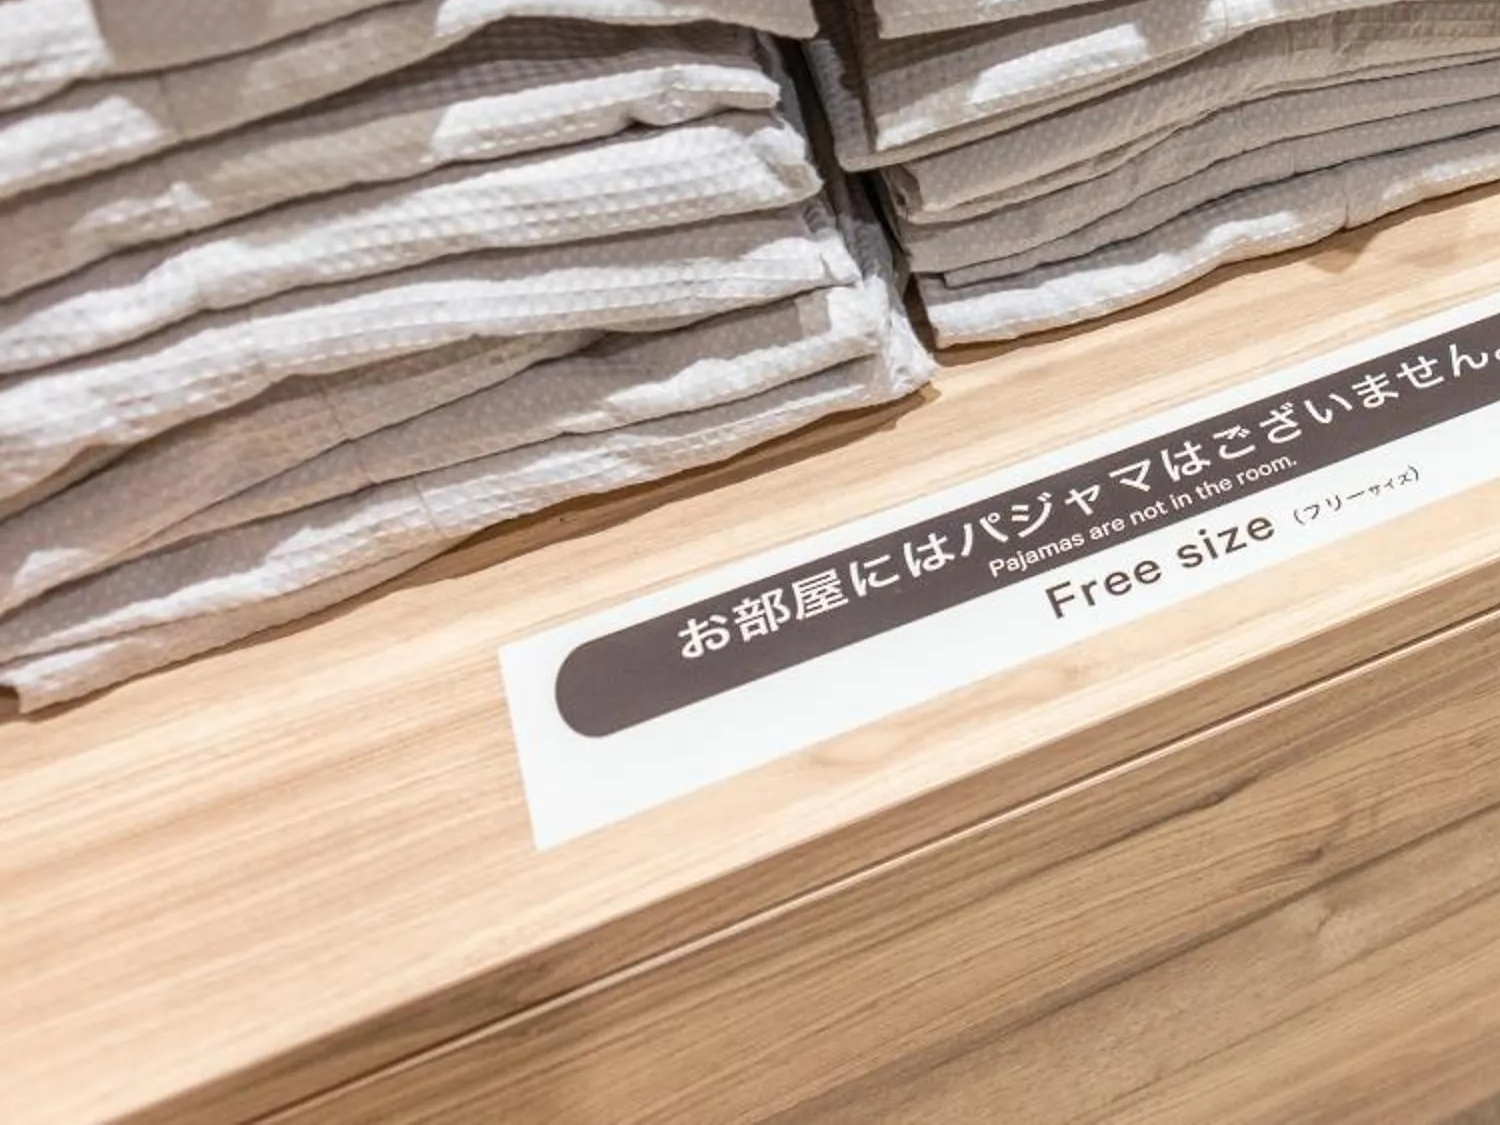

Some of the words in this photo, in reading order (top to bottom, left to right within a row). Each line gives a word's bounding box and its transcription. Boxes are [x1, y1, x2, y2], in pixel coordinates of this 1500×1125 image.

[988, 530, 1086, 579] Pajamas
[1089, 514, 1126, 541] are
[1129, 499, 1169, 527] not
[1169, 493, 1194, 512] in
[1195, 474, 1233, 501] the
[1236, 453, 1298, 487] room.
[1045, 558, 1162, 619] Free
[1176, 516, 1276, 569] size
